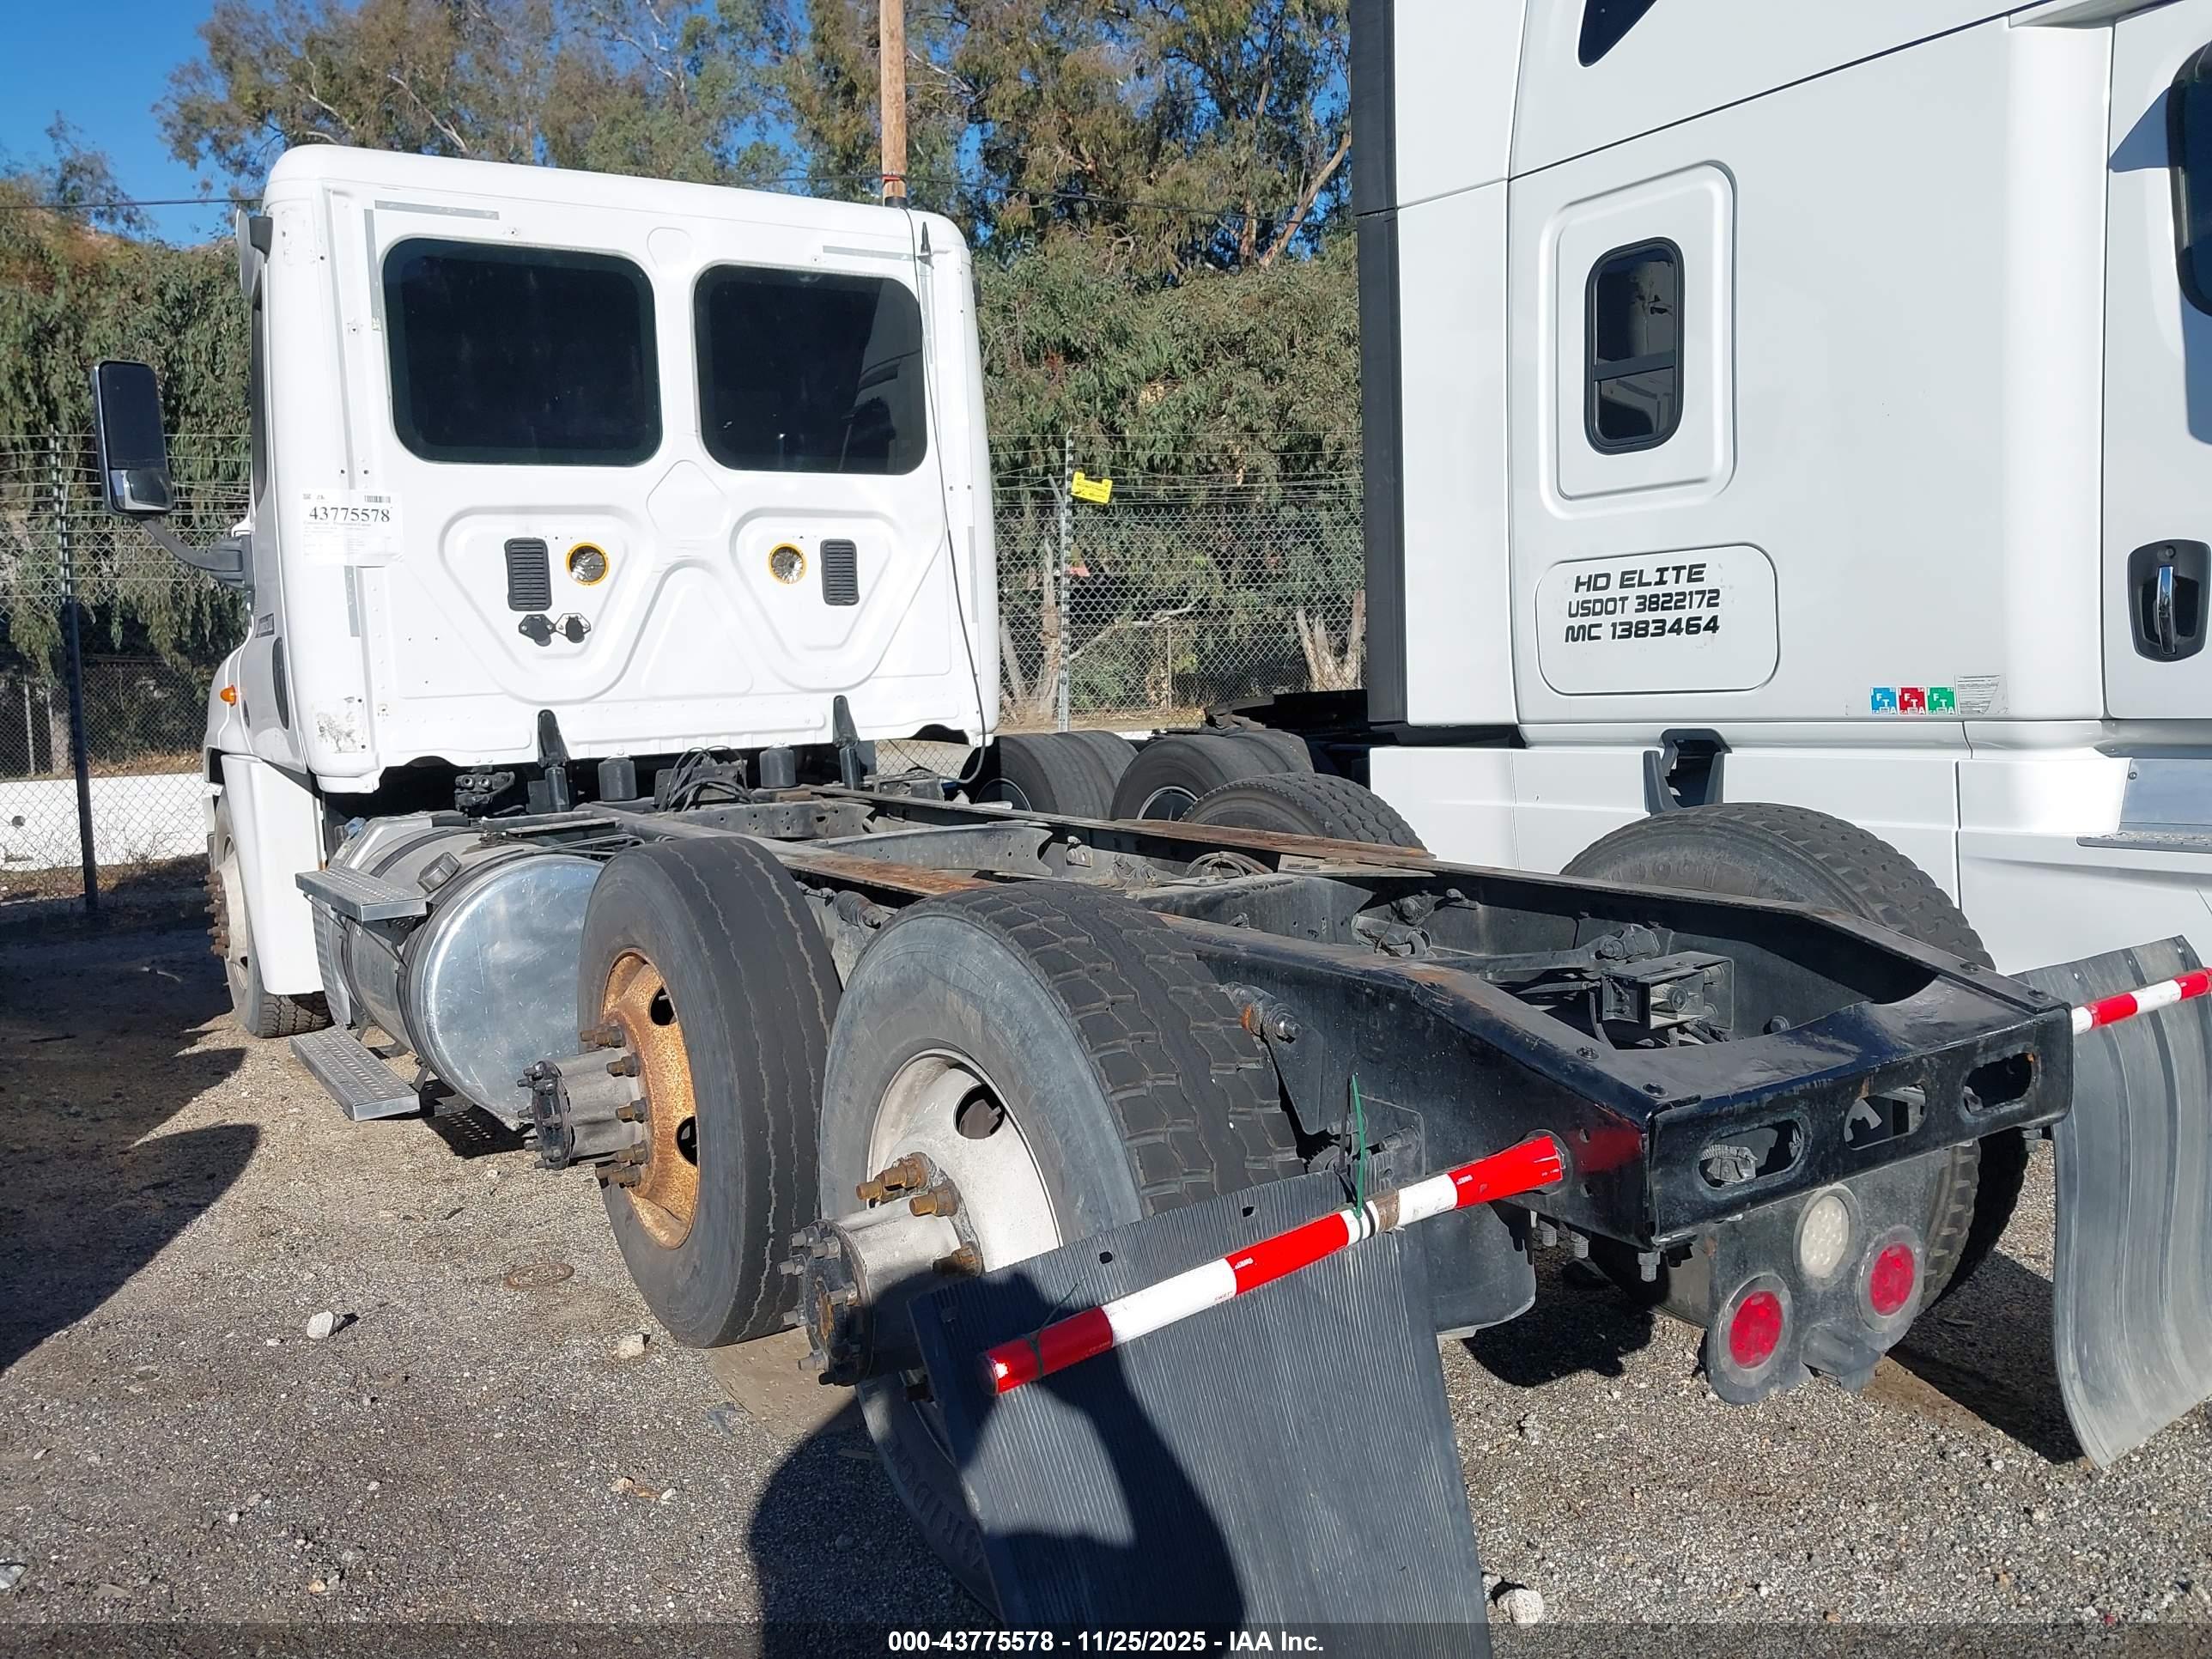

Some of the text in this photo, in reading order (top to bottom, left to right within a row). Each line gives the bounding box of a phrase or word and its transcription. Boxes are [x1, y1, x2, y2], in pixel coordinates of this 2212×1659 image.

[309, 506, 391, 523] 43775578
[1574, 563, 1707, 593] HD ELITE
[1568, 588, 1721, 618] USDOT 3822172
[1565, 615, 1720, 643] MC 1383464
